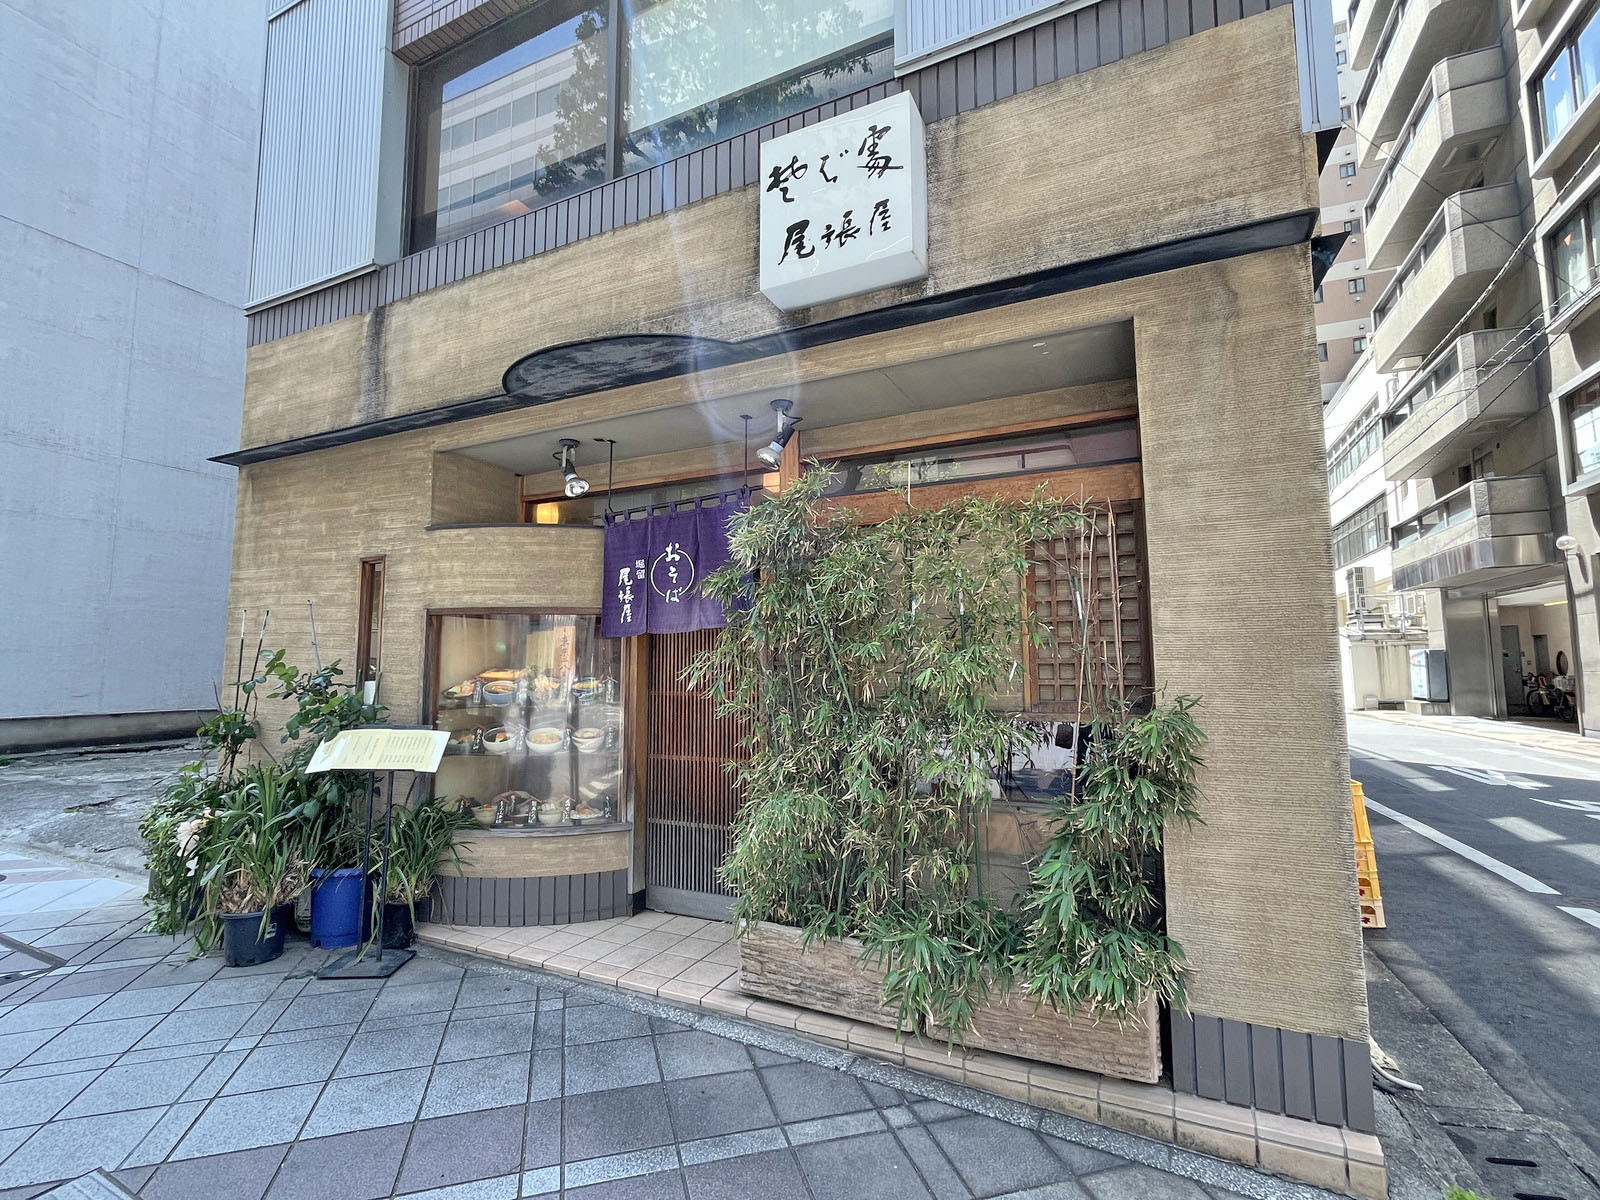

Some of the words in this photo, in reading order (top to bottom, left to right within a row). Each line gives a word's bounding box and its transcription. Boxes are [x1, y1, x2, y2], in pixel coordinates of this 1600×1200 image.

[778, 199, 892, 266] 尾張屋
[618, 567, 635, 624] 尾張屋
[665, 542, 682, 603] おそば
